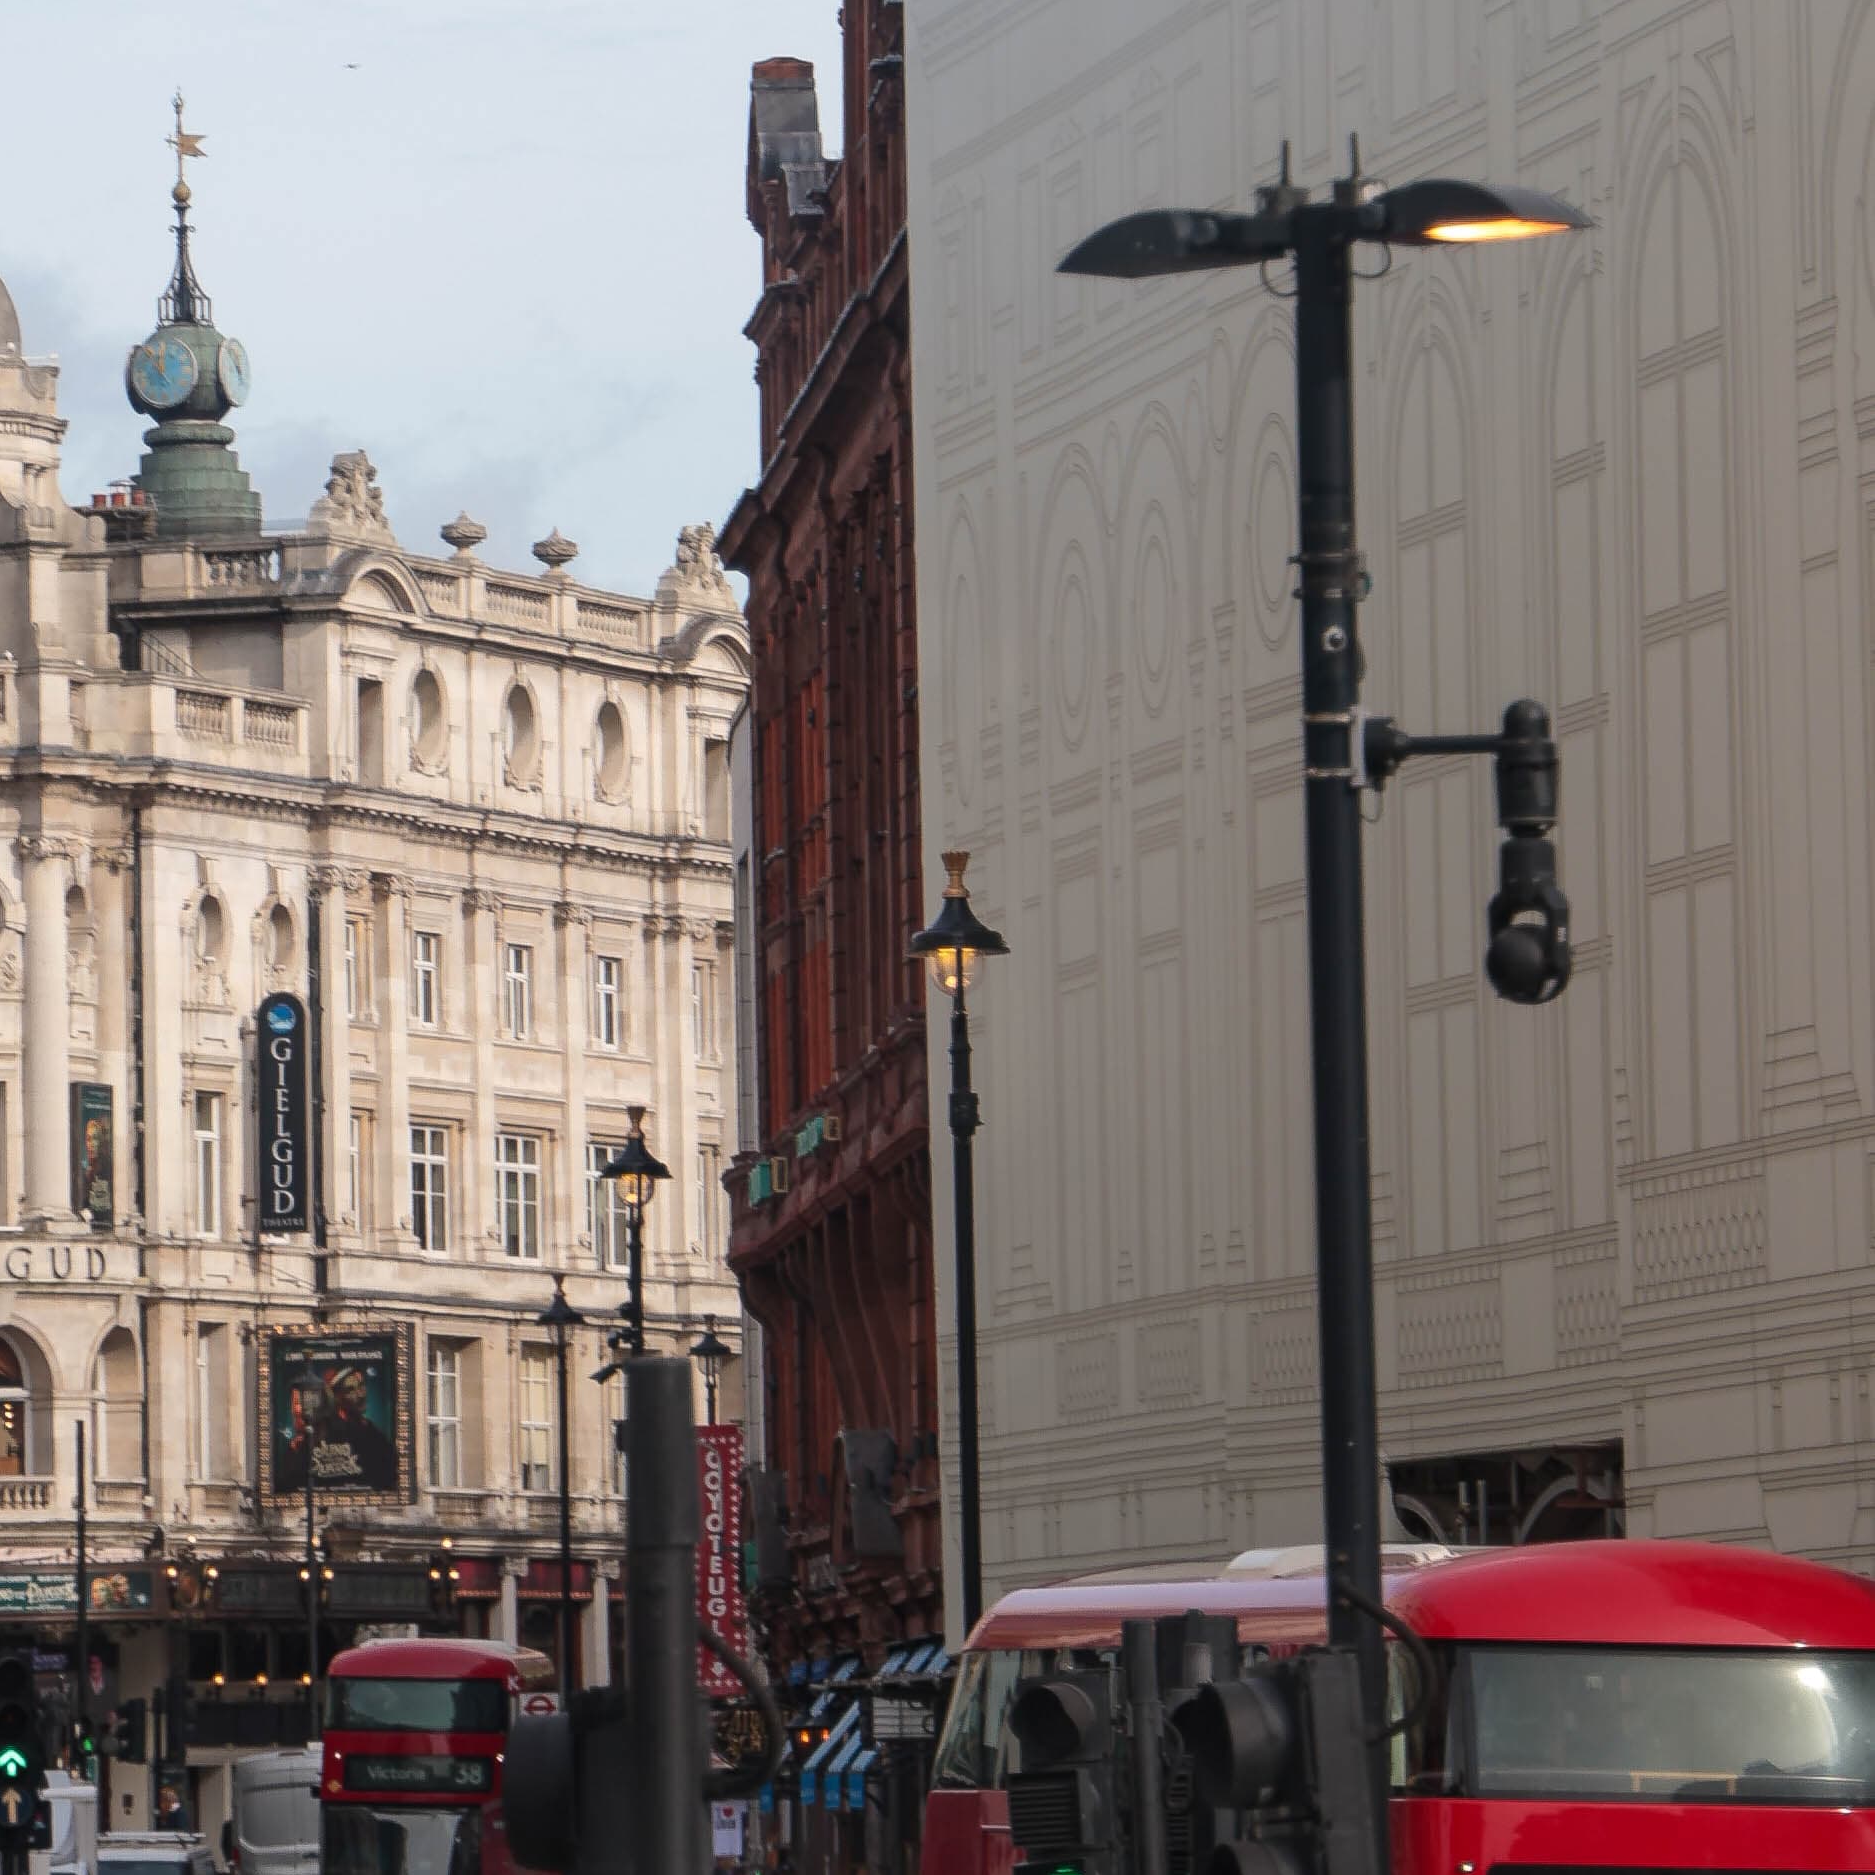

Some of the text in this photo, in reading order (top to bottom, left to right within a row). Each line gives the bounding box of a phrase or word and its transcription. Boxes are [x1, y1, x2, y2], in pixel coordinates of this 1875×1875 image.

[270, 1037, 295, 1214] GIELGUD
[703, 1450, 727, 1638] COYOTE UGL
[367, 1764, 483, 1786] Victoria 38
